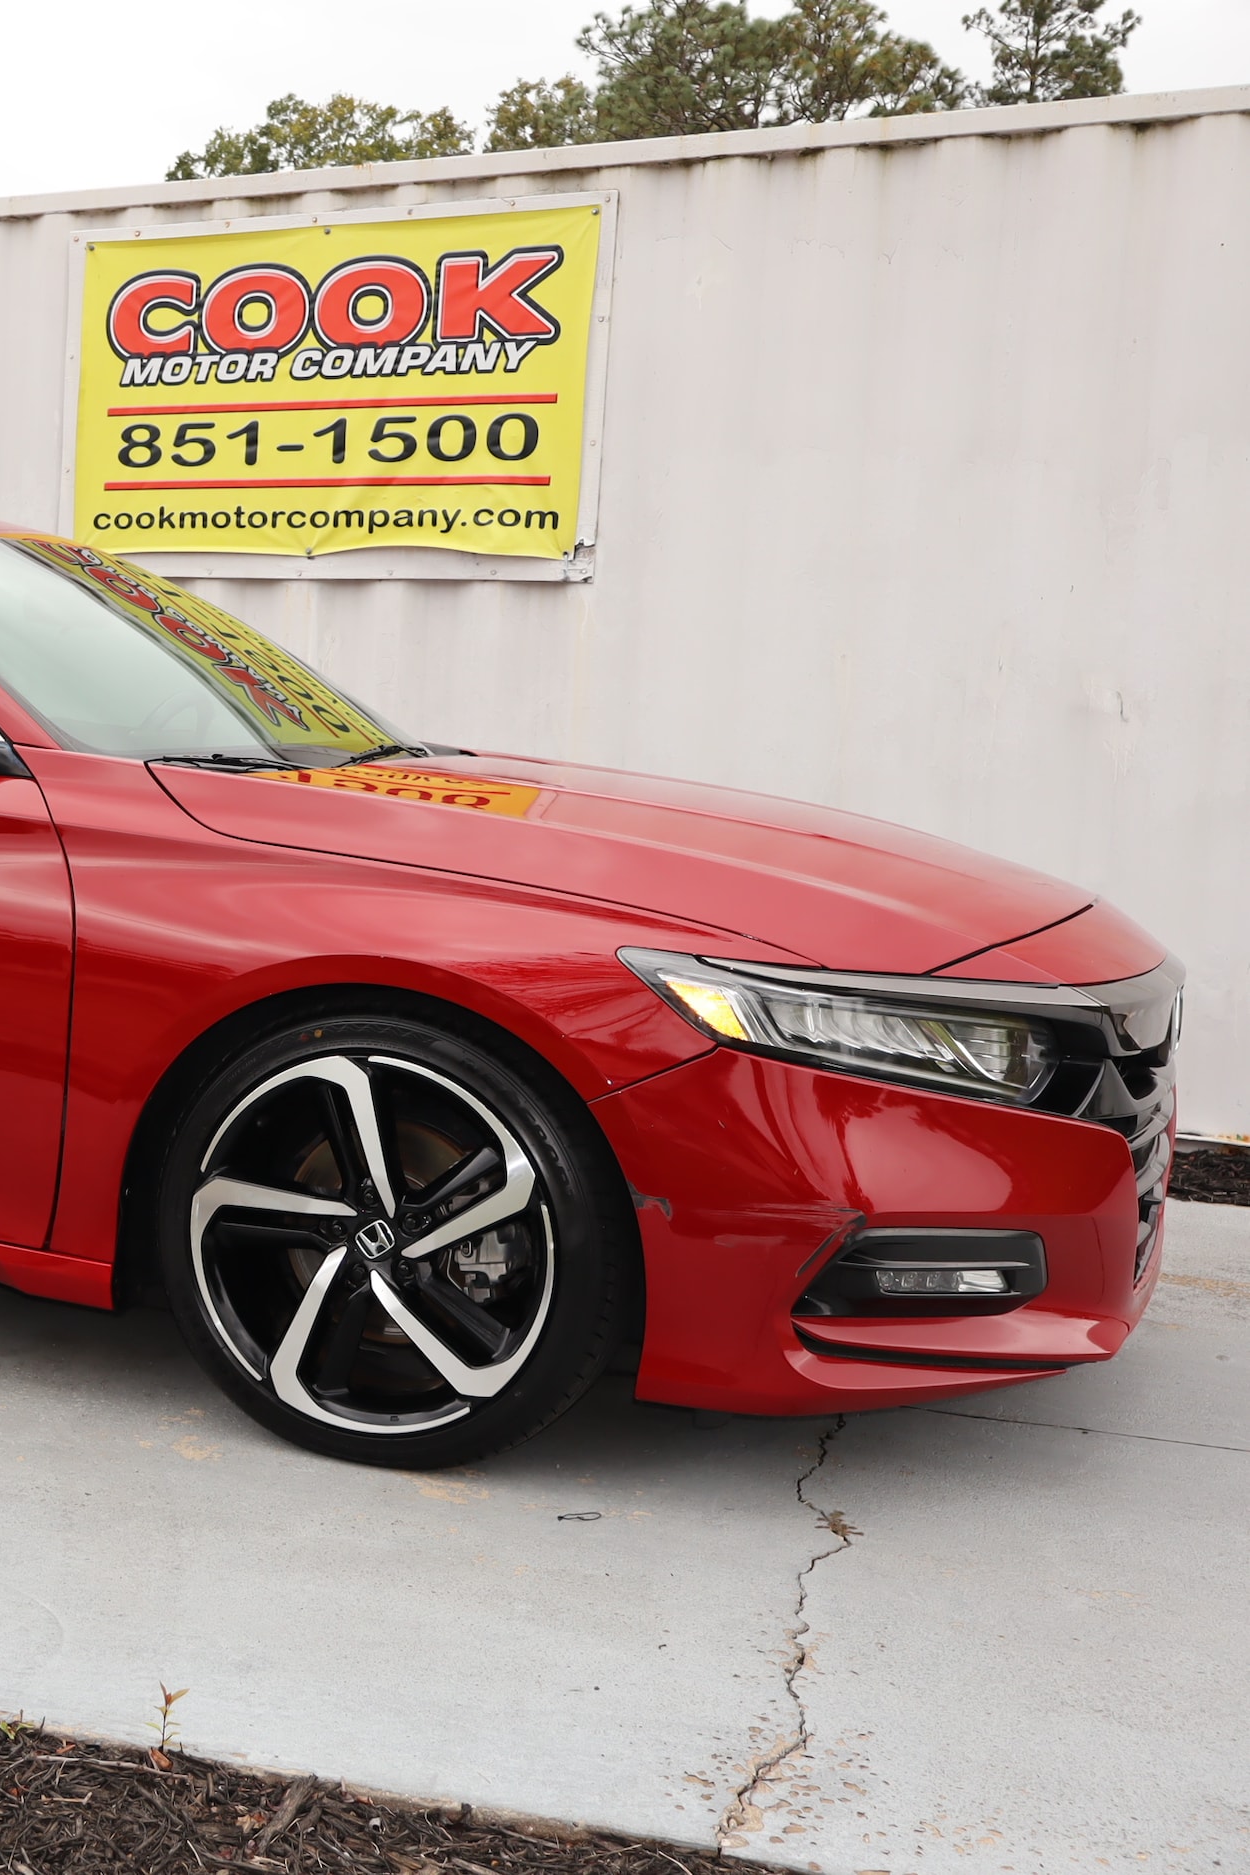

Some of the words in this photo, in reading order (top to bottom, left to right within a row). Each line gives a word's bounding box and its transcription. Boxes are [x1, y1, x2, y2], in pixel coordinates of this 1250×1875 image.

[107, 245, 563, 360] COOK
[120, 350, 279, 387] MOTOR
[289, 338, 536, 381] COMPANY
[117, 413, 539, 467] 851-1500
[93, 506, 559, 534] cookmotorcompany.com
